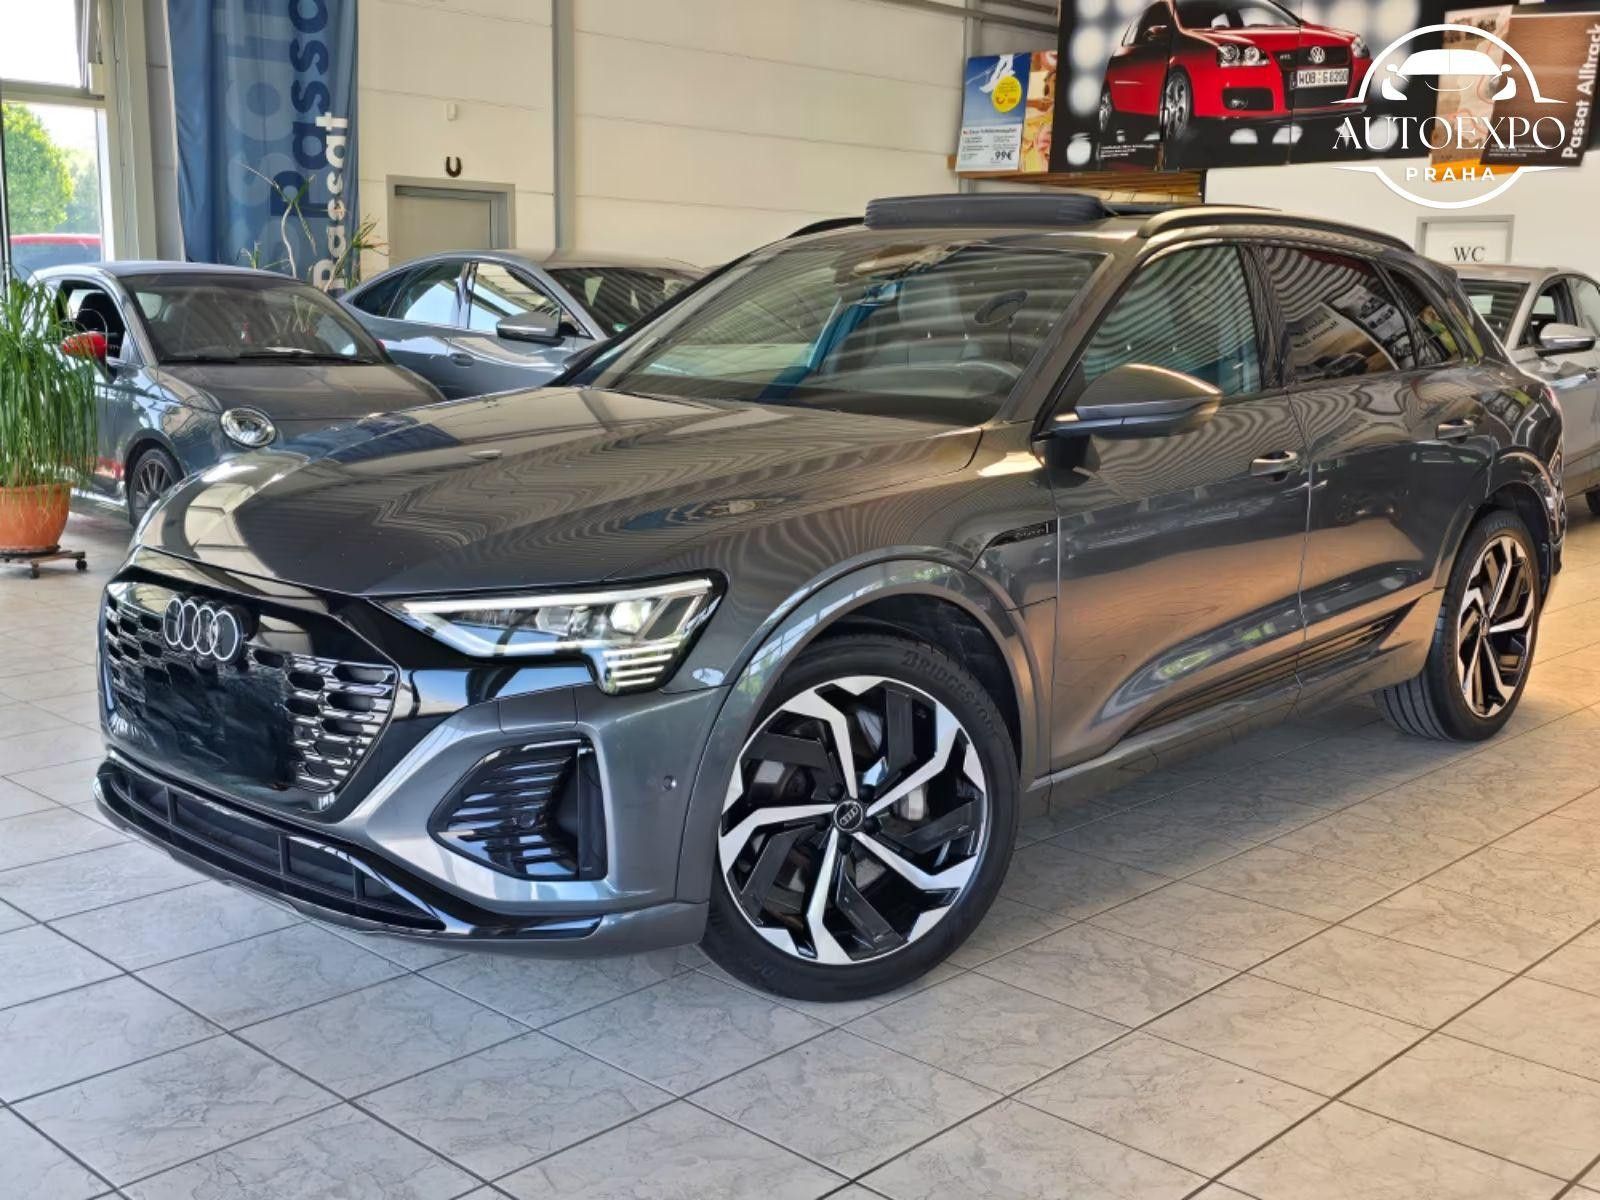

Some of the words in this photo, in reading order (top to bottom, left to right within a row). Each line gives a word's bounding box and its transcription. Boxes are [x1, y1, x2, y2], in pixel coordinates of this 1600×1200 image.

[1561, 100, 1590, 159] Passat
[1577, 23, 1600, 96] Alltrack
[312, 111, 348, 290] Passat
[1453, 246, 1485, 262] WC
